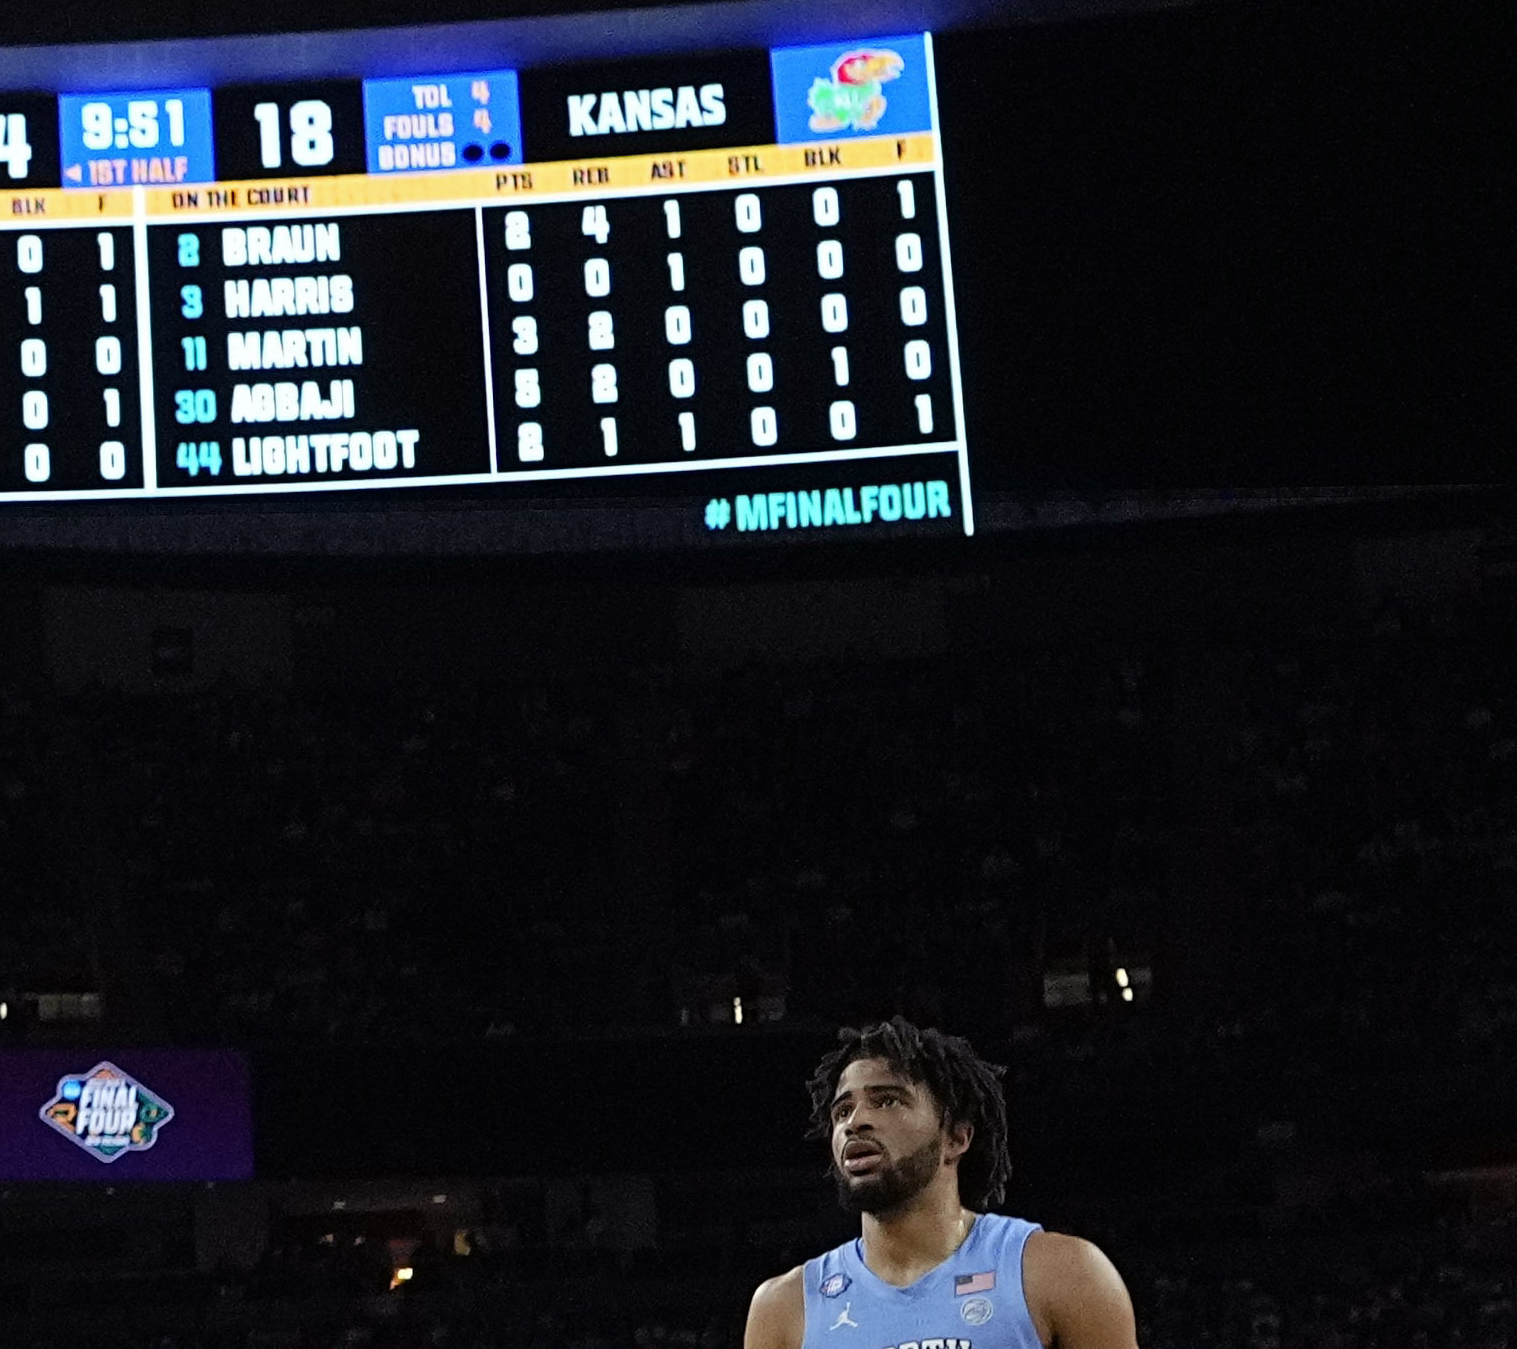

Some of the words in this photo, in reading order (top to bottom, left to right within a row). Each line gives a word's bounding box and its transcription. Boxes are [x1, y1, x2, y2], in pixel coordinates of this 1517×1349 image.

[412, 85, 451, 109] TOL
[471, 81, 489, 104] 4
[567, 83, 726, 137] KANSAS
[81, 99, 185, 149] 9:51
[254, 100, 334, 168] 18
[384, 114, 454, 140] FOULS
[473, 109, 491, 134] 4
[132, 156, 188, 183] HALF
[379, 142, 456, 170] BONUS
[172, 191, 195, 209] ON
[207, 189, 237, 208] THE
[247, 186, 311, 206] COURT
[495, 172, 533, 191] PTS
[651, 161, 687, 180] AST
[177, 233, 200, 267] 2
[222, 223, 341, 267] BRAUN
[664, 200, 680, 238] 1
[735, 194, 761, 232] 0
[813, 187, 839, 226] 0
[897, 180, 915, 218] 1
[18, 235, 42, 273] 0
[98, 233, 114, 270] 1
[181, 284, 203, 319] 3
[224, 275, 354, 318] HARRIS
[508, 264, 533, 301] 0
[584, 259, 610, 296] 0
[668, 253, 684, 291] 1
[739, 247, 765, 285] 0
[817, 240, 843, 279] 0
[896, 233, 922, 272] 0
[25, 287, 41, 324] 1
[100, 285, 116, 322] 1
[181, 336, 207, 371] 11
[227, 327, 363, 371] MARTIN
[175, 389, 217, 424] 30
[231, 380, 355, 423] AGBAJI
[176, 441, 222, 476] 44
[232, 429, 419, 477] LIGHTFOOT
[601, 418, 617, 456] 1
[679, 412, 695, 451] 1
[751, 407, 777, 446] 0
[830, 401, 856, 440] 0
[915, 394, 933, 433] 1
[25, 444, 50, 481] 0
[100, 441, 125, 479] 0
[80, 1083, 138, 1111] FINAL
[76, 1109, 137, 1134] FOUR
